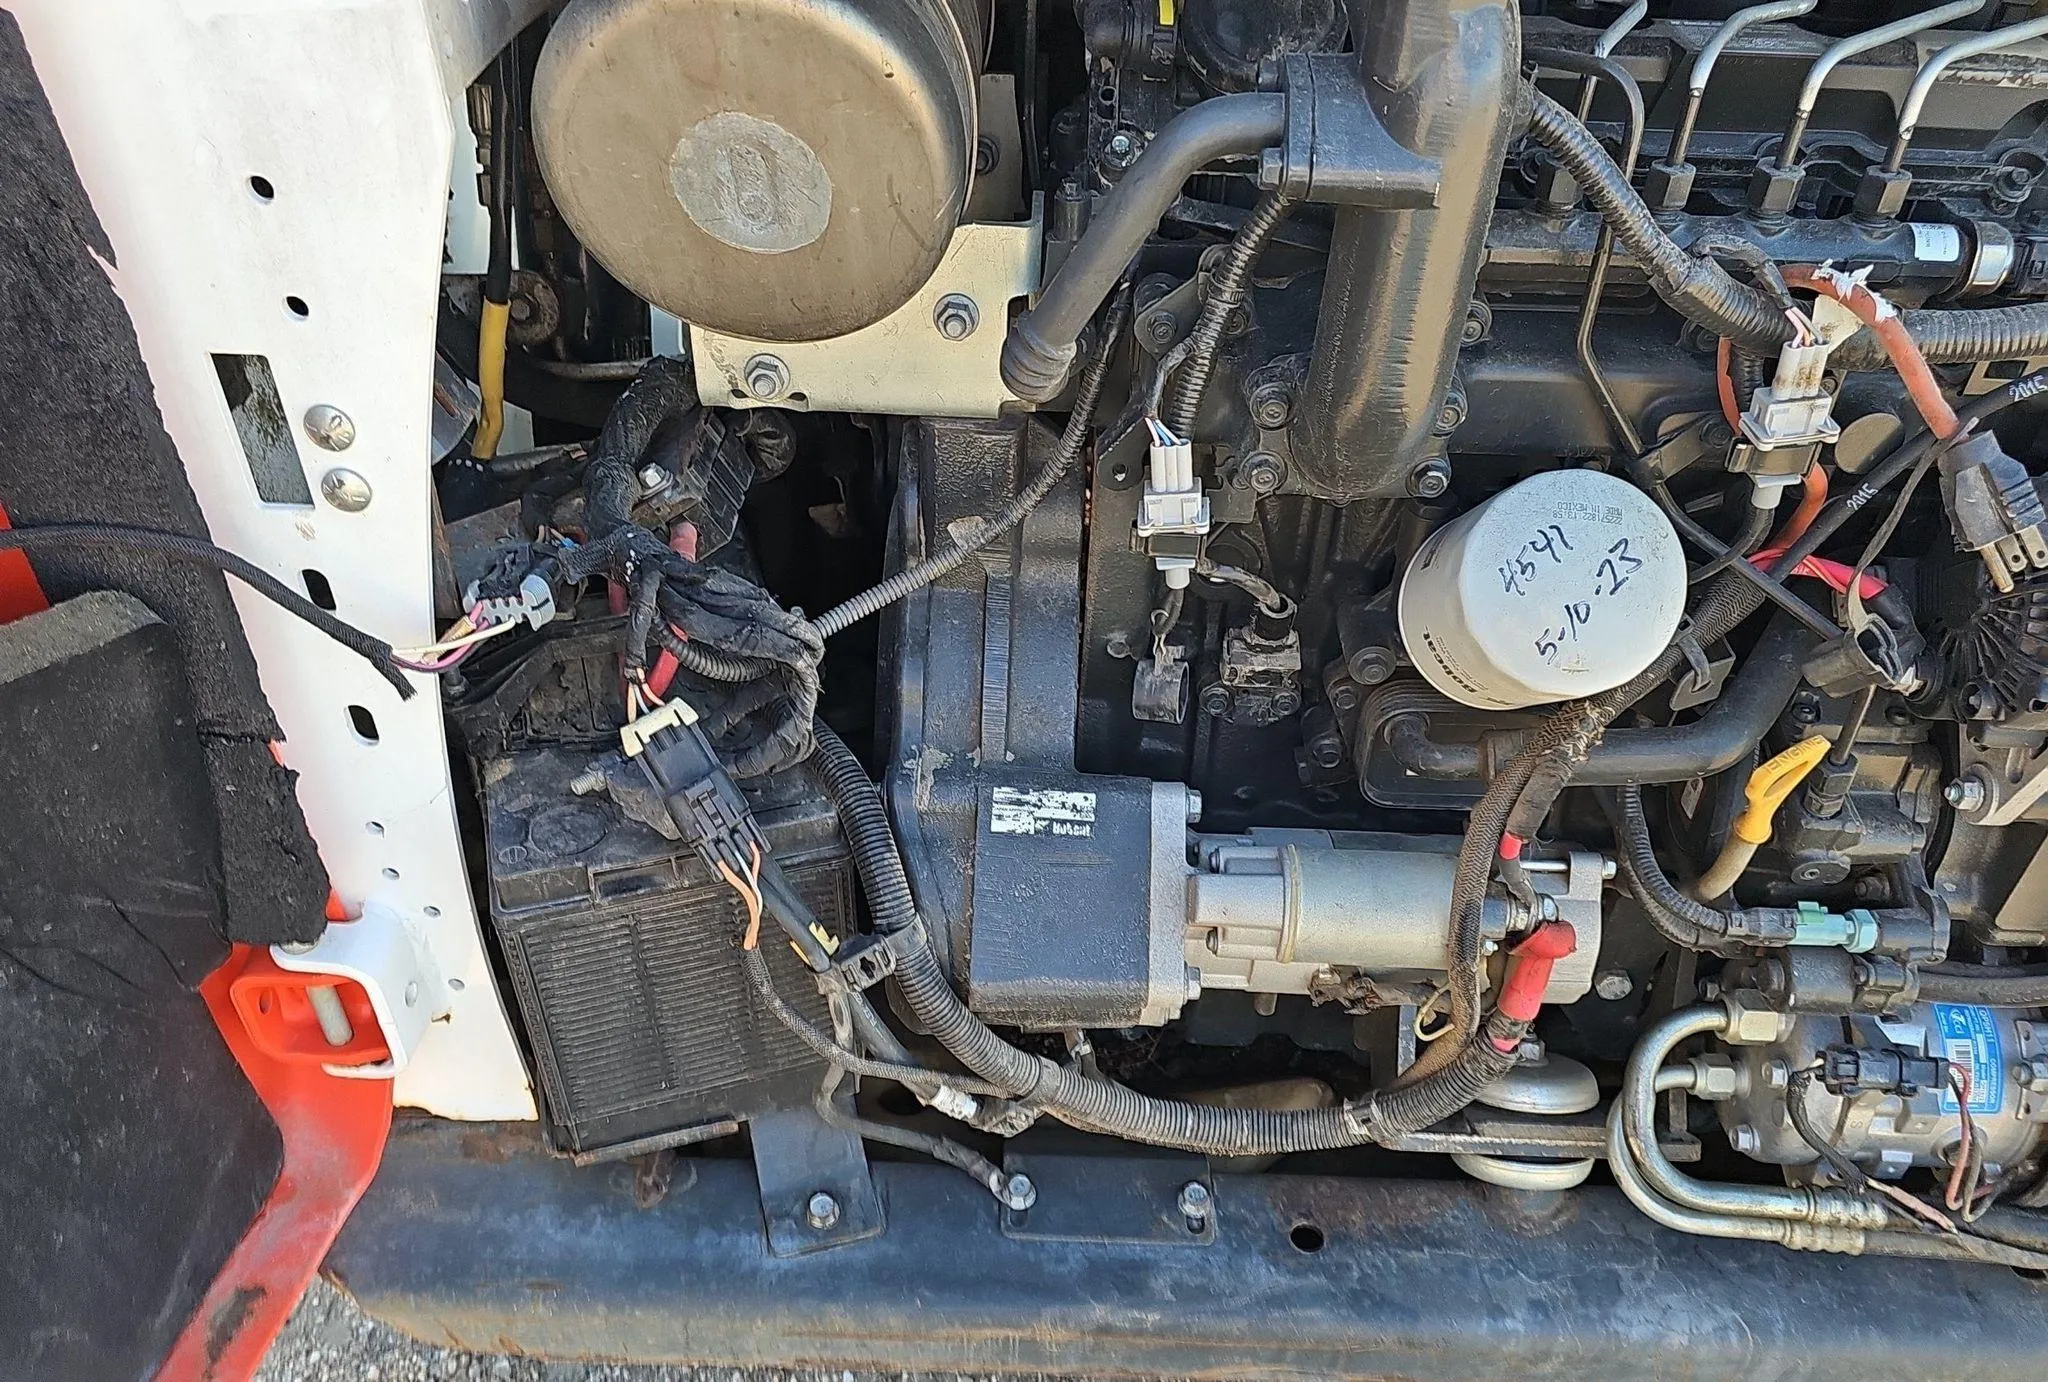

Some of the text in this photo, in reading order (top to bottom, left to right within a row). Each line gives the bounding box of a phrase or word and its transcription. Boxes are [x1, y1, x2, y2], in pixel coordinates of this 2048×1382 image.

[1557, 501, 1623, 517] MADE IN MEXICO
[1846, 482, 1879, 511] 2015
[1767, 737, 1824, 773] ENGINE
